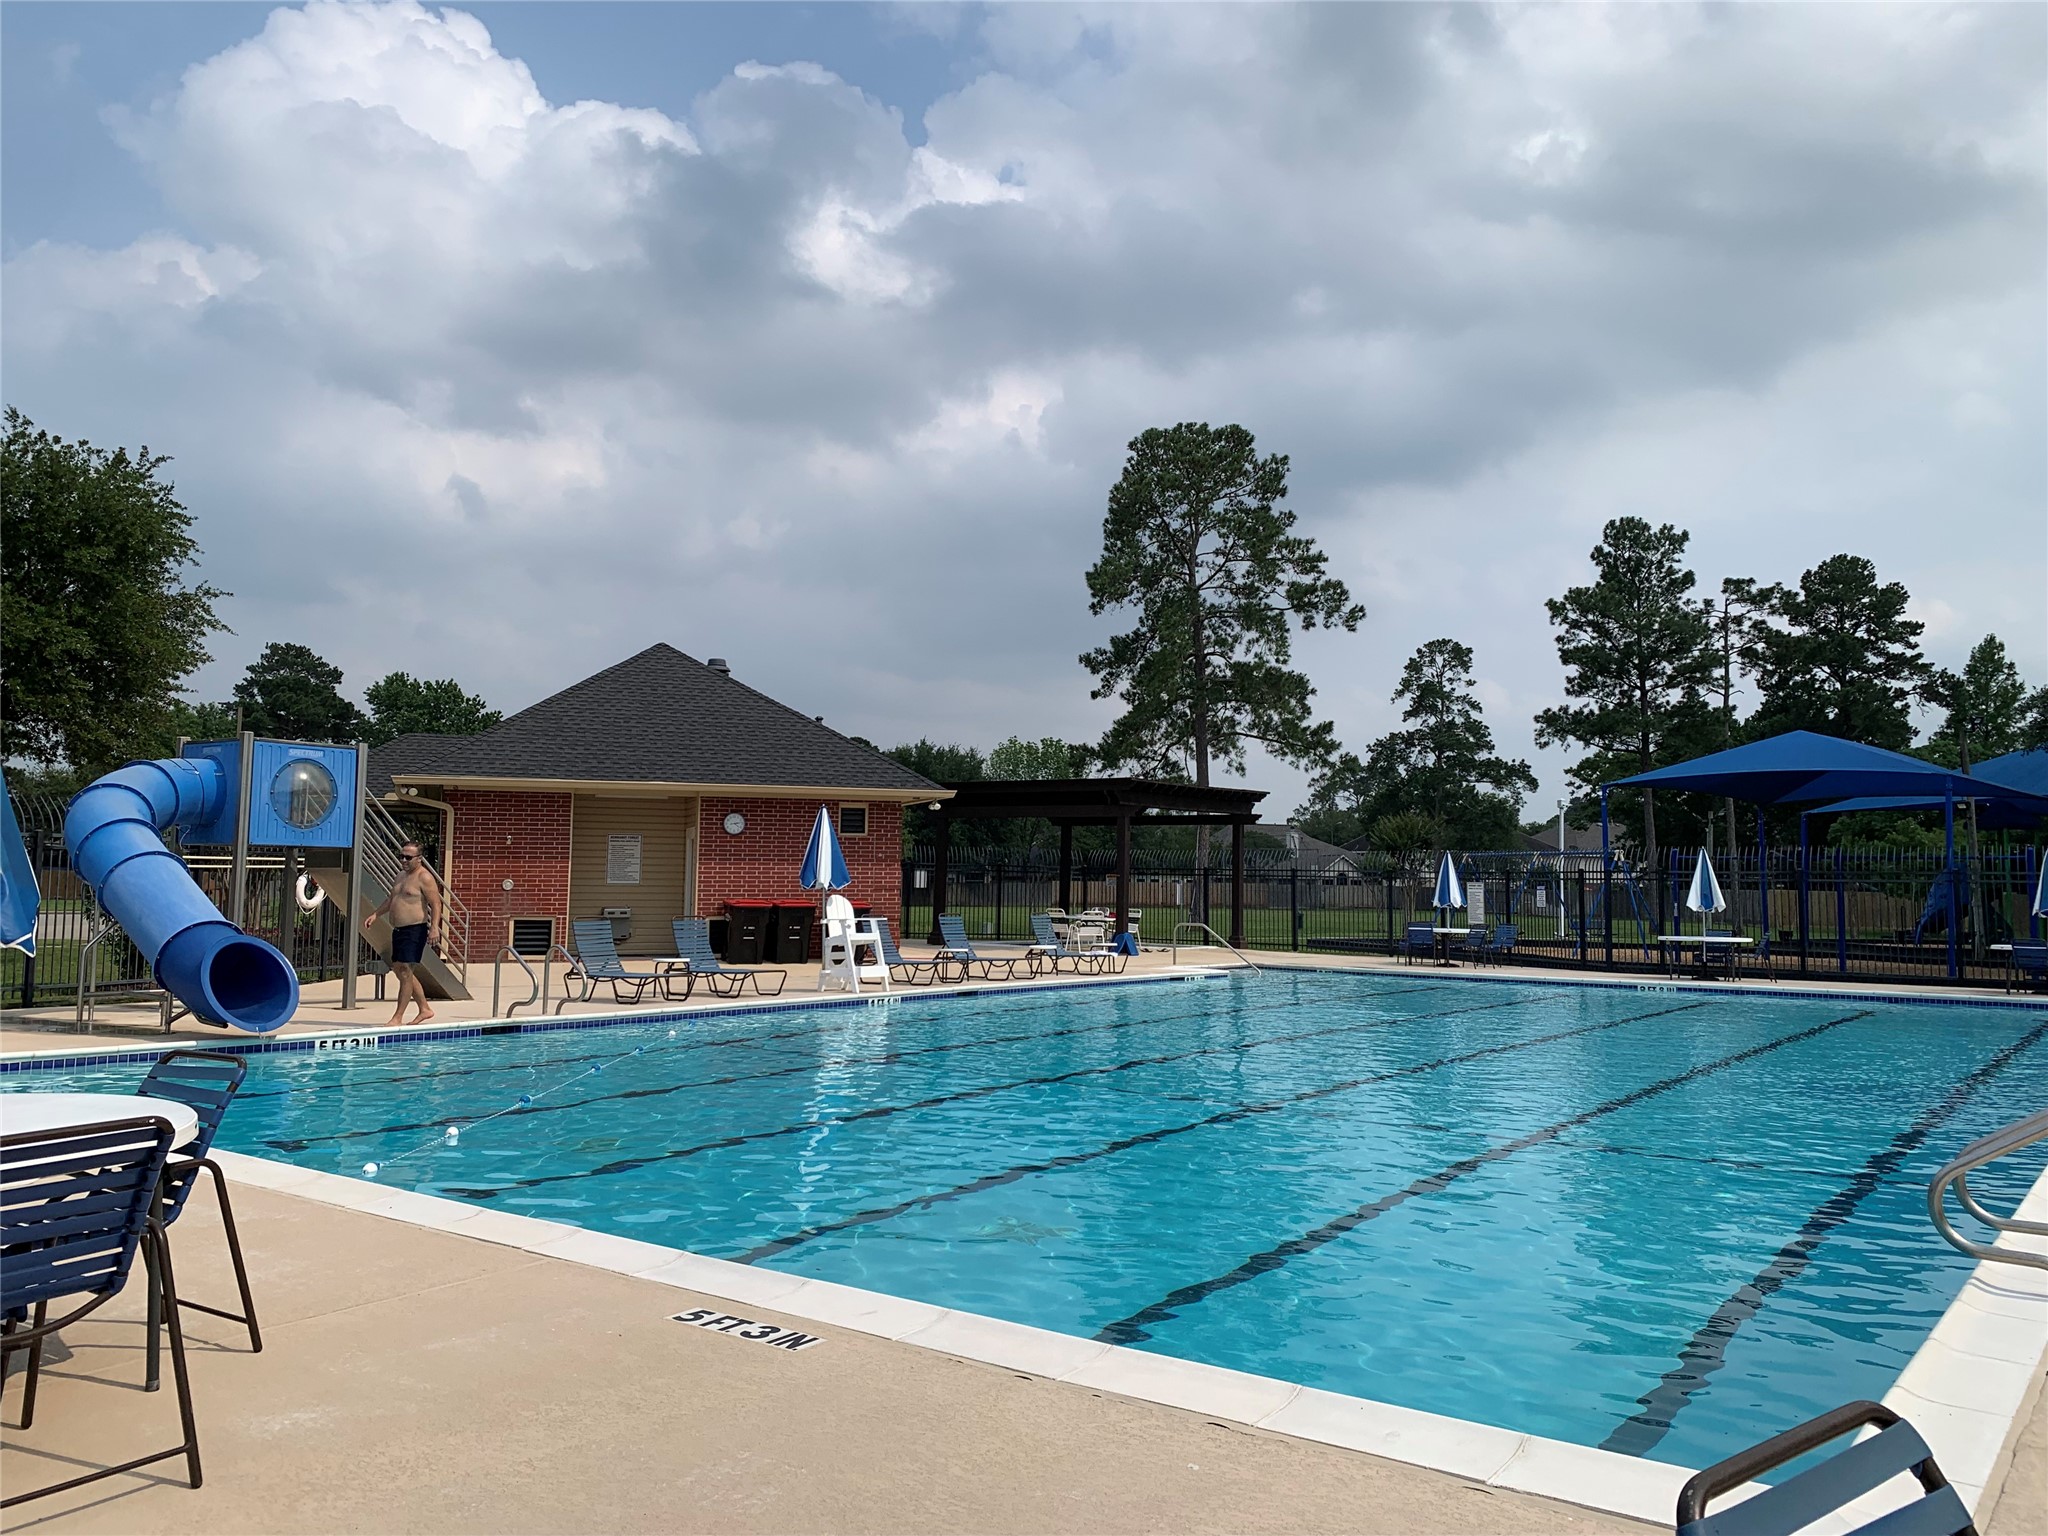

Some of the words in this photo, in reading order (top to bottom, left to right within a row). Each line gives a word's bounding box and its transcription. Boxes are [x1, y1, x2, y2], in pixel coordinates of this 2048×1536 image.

[288, 749, 325, 758] SPECTRUM
[672, 1309, 716, 1322] 5
[699, 1315, 756, 1333] FT.
[739, 1325, 782, 1340] 3
[765, 1332, 820, 1351] IN.
